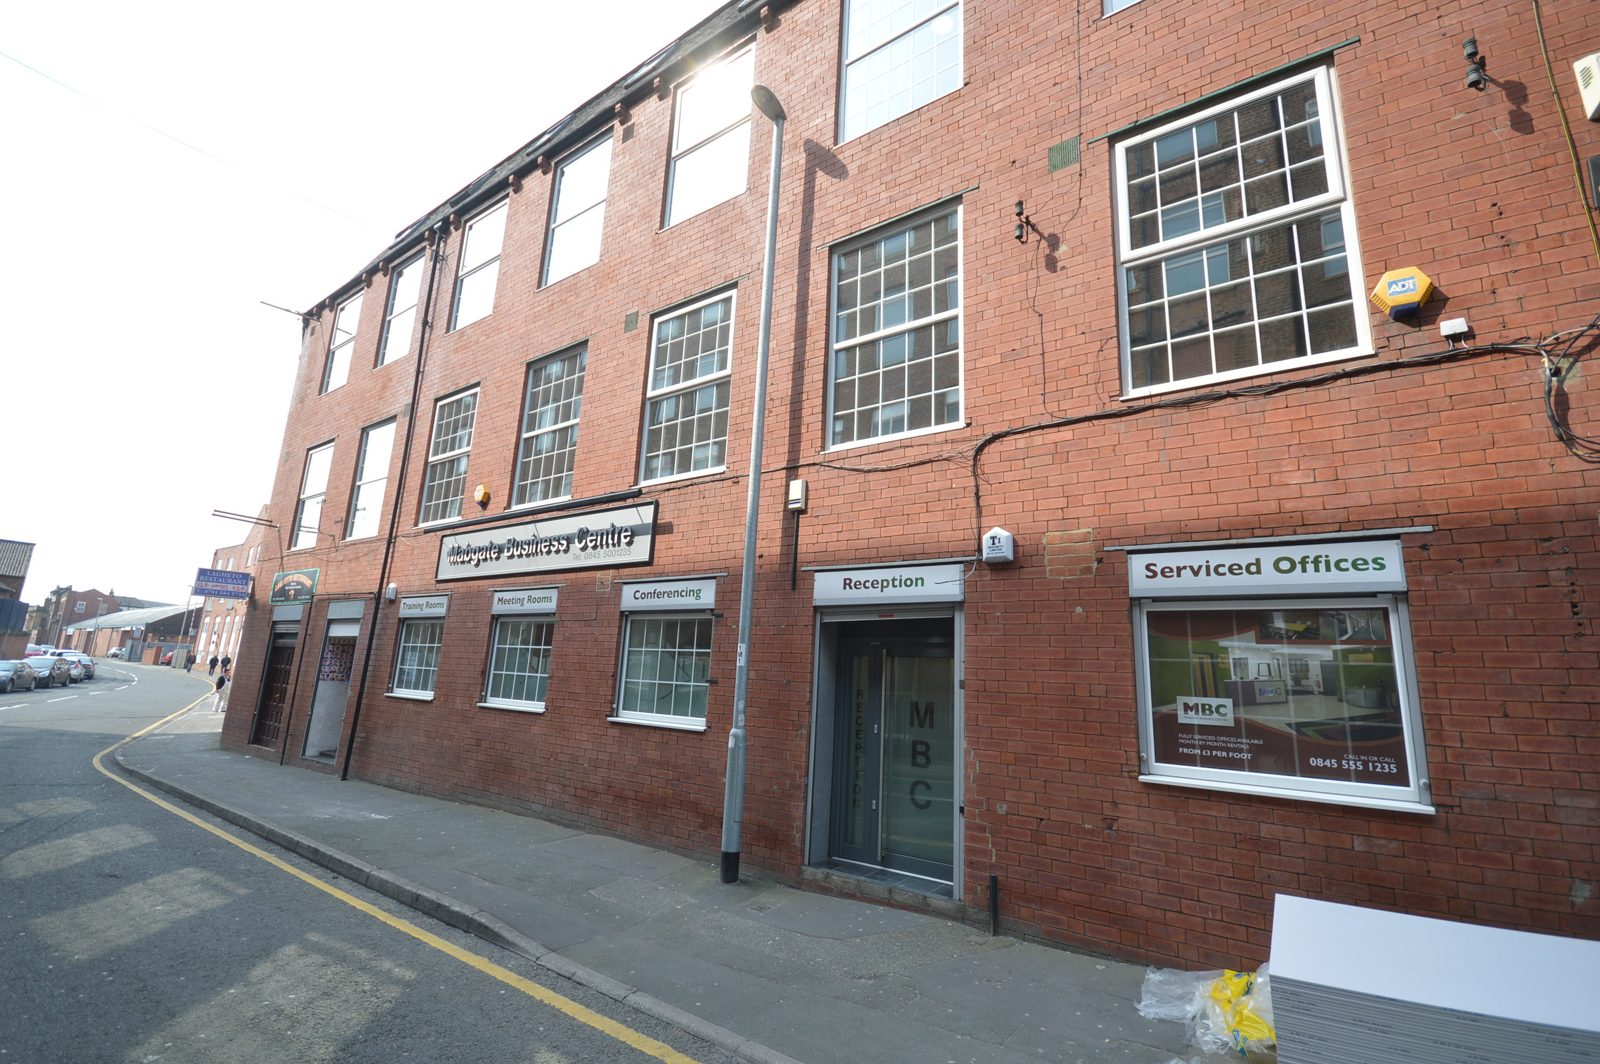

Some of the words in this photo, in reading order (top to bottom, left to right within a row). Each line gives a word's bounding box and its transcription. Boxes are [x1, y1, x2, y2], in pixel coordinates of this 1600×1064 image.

[1388, 278, 1416, 294] ADT
[447, 543, 500, 566] Mabgate
[504, 535, 568, 558] Business
[575, 523, 632, 550] Centre
[584, 551, 601, 560] 0845
[1144, 558, 1262, 579] Serviced
[1272, 554, 1387, 574] Offices
[200, 575, 247, 585] RESTAURANT
[842, 575, 925, 592] Reception
[497, 596, 525, 606] Meeting
[527, 594, 552, 604] Rooms
[633, 587, 702, 600] Conferencing
[402, 602, 424, 611] Training
[425, 601, 445, 609] Rooms
[1183, 702, 1228, 717] MBC
[1179, 747, 1201, 755] FROM
[1212, 750, 1228, 758] PER
[1229, 752, 1253, 760] FOOT
[1309, 757, 1338, 768] 0845
[1342, 760, 1363, 770] 555
[1368, 762, 1398, 773] 1235
